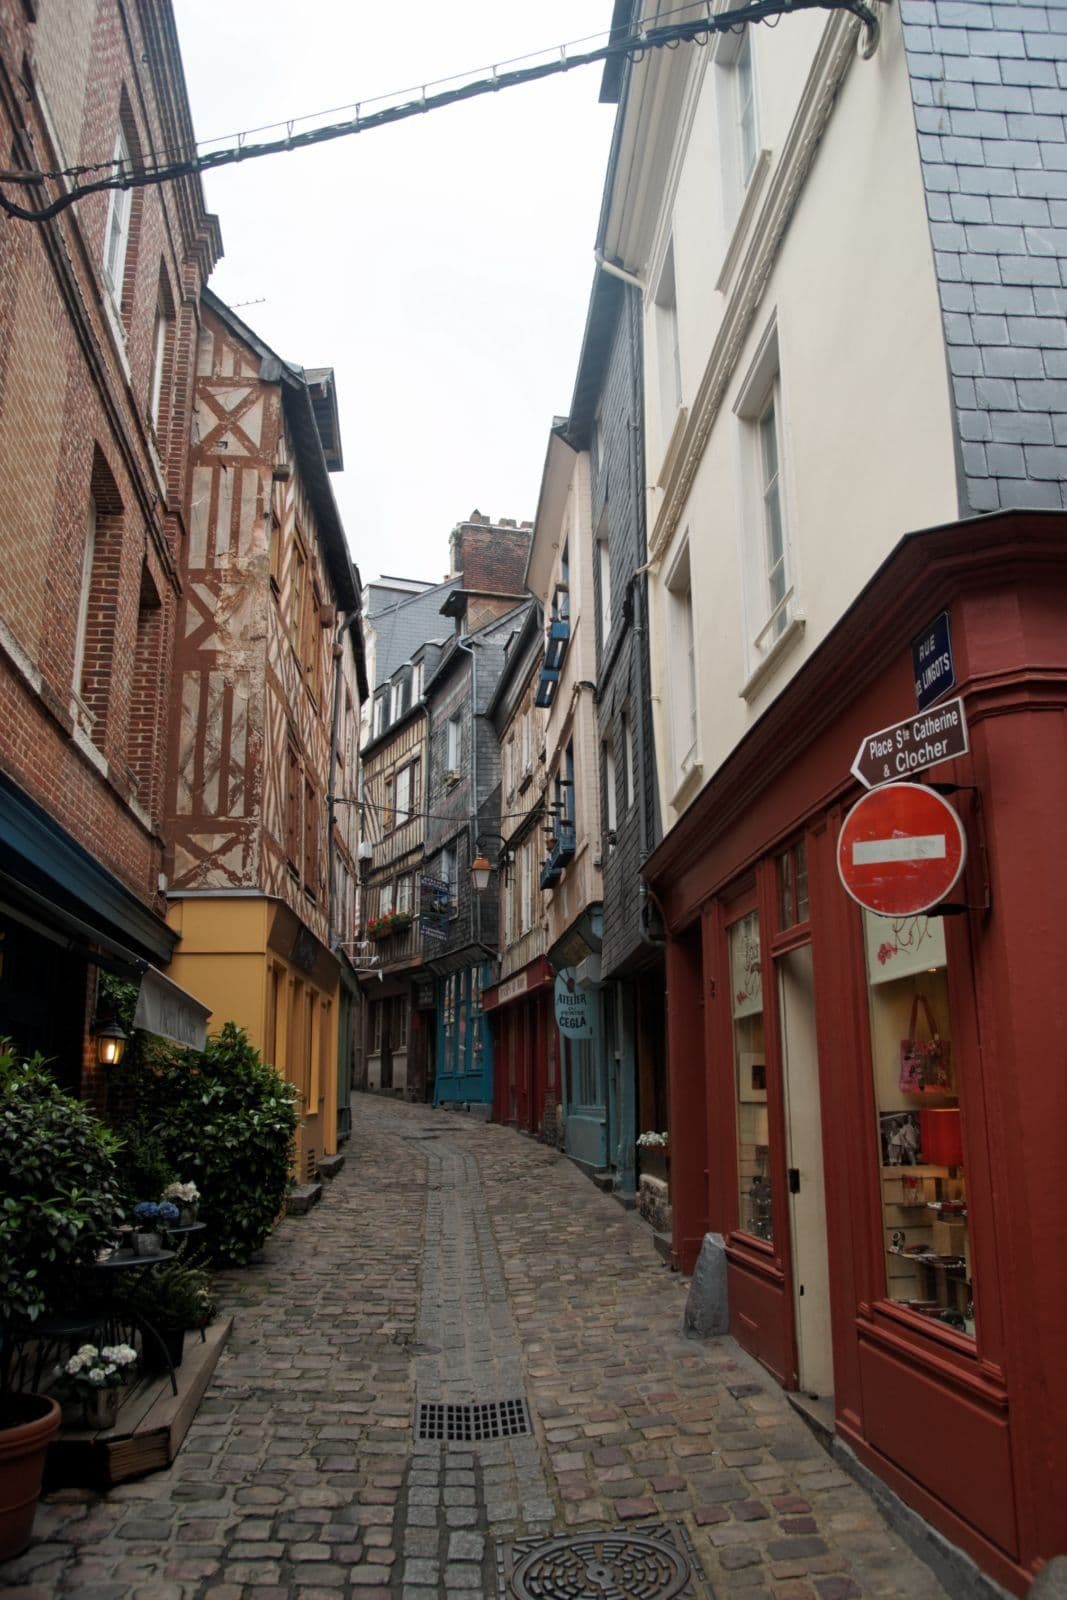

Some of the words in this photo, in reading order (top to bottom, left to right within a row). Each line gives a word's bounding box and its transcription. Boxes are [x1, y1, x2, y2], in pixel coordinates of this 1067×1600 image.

[919, 634, 936, 662] RUE
[922, 652, 950, 689] LINGOTS
[870, 737, 893, 761] Place
[896, 728, 910, 748] Ste
[913, 710, 959, 741] Catherine
[883, 764, 891, 777] &
[896, 738, 948, 772] Clocher
[558, 993, 587, 1006] ATELIER
[559, 1016, 586, 1029] CEGLA
